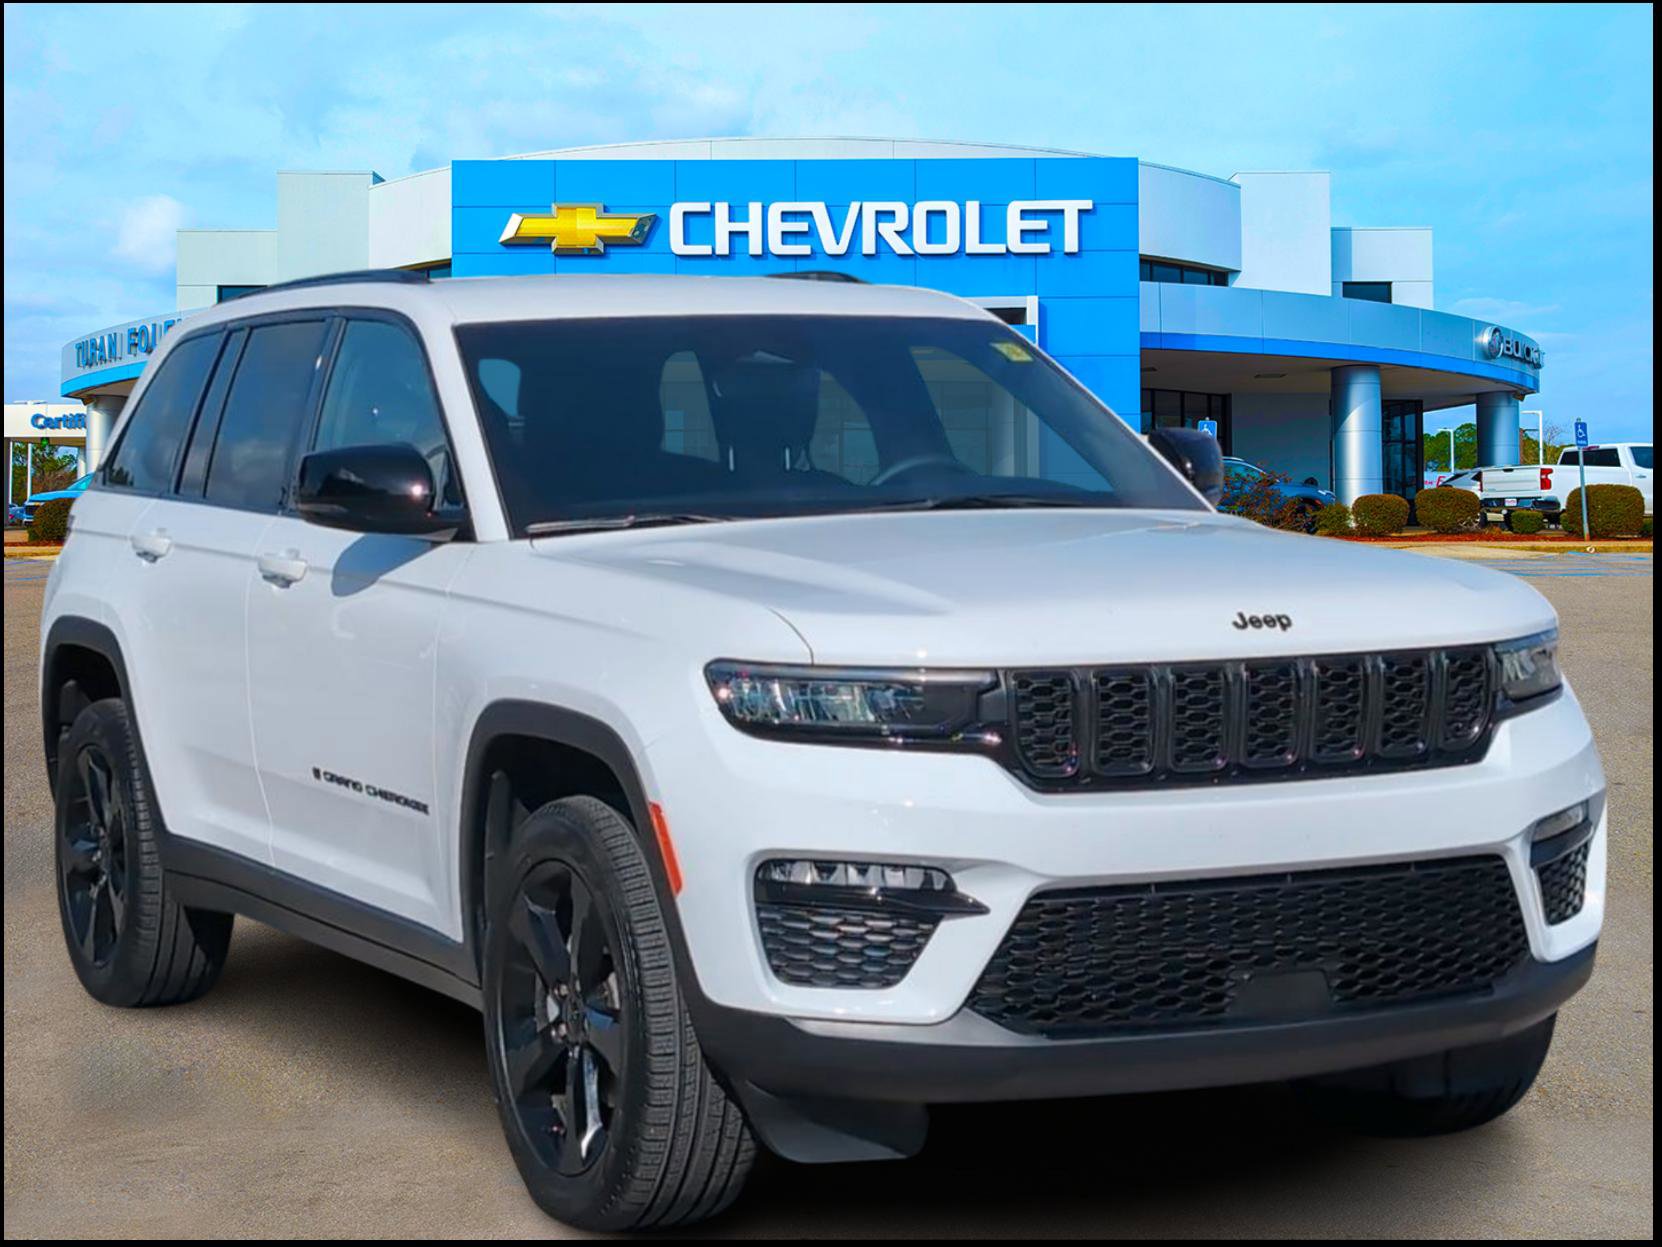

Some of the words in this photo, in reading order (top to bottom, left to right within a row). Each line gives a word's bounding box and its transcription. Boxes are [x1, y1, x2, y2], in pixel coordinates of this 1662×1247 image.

[669, 199, 1093, 256] CHEVROLET
[75, 332, 117, 369] TURAN
[1231, 611, 1293, 632] Jeep
